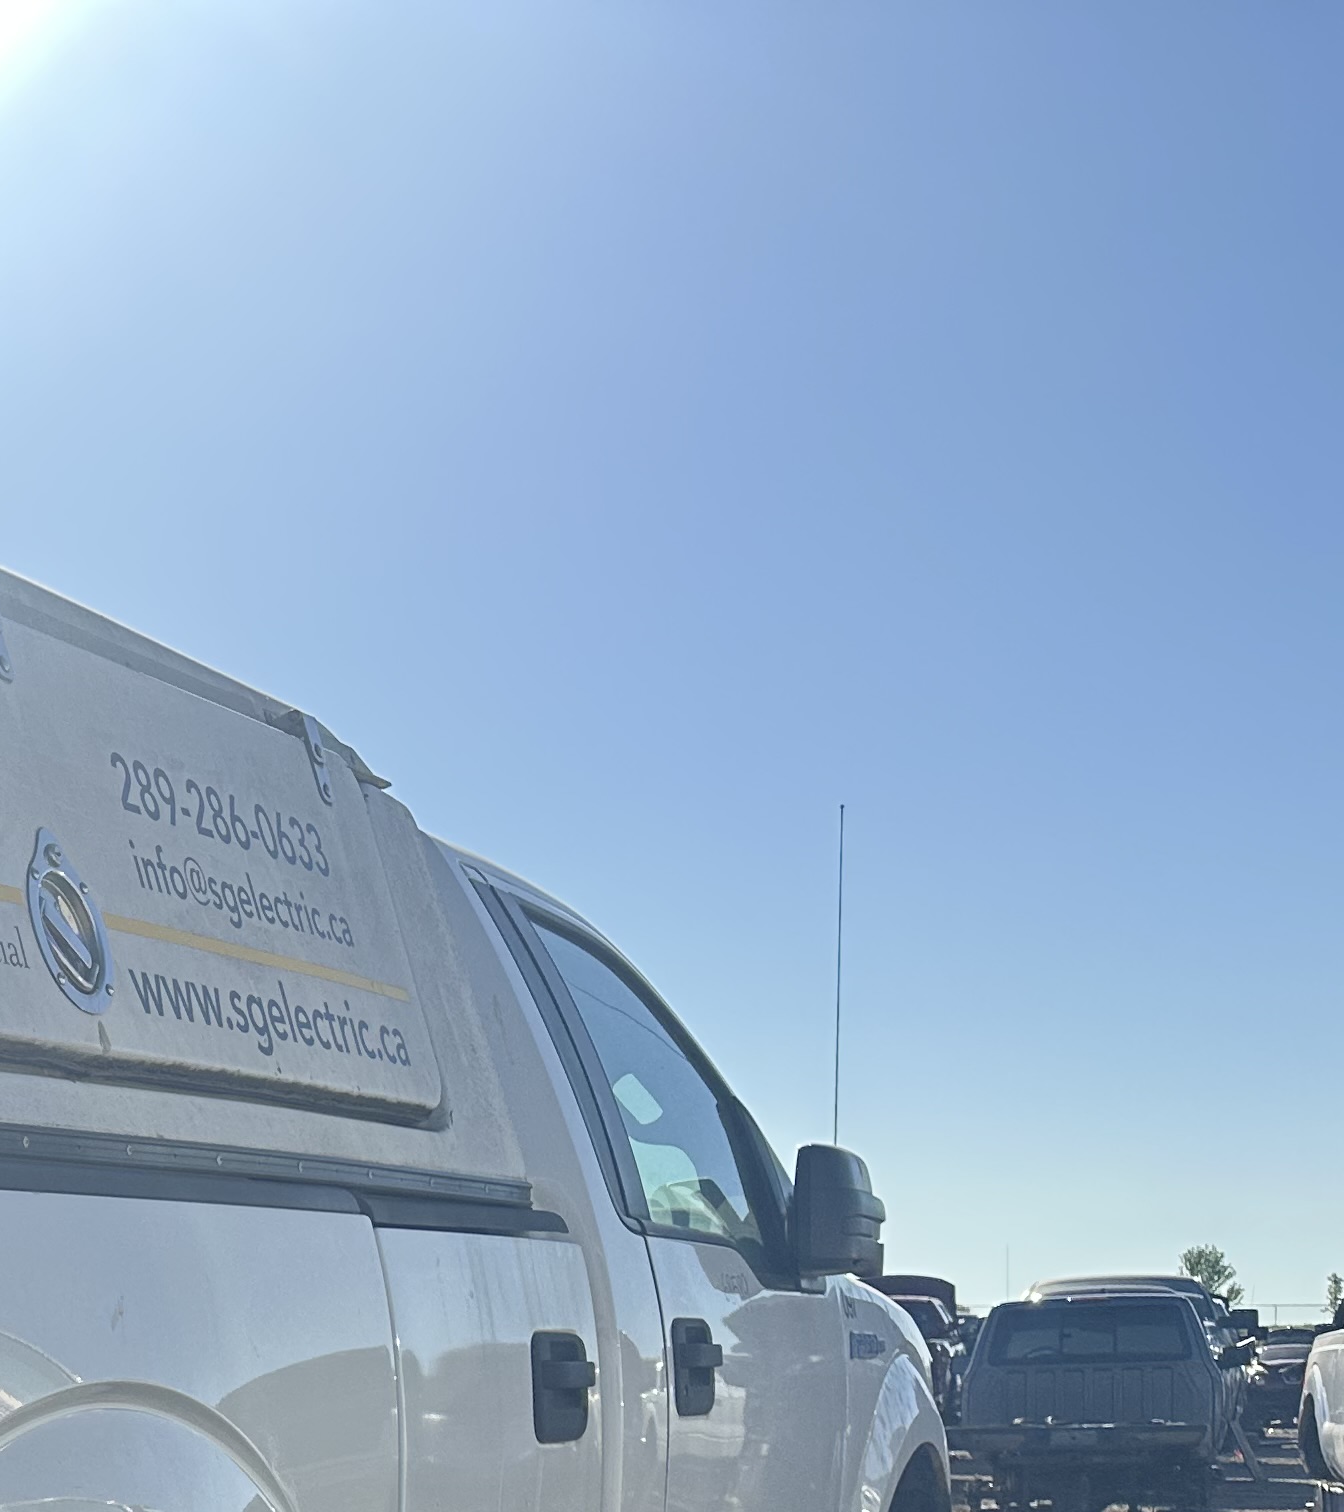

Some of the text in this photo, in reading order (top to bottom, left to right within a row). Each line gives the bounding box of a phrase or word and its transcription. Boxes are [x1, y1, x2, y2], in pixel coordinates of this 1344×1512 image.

[110, 751, 331, 877] 289-286-0633
[128, 838, 355, 948] info@sgelectric.ca
[127, 967, 412, 1068] www.sgelectric.ca
